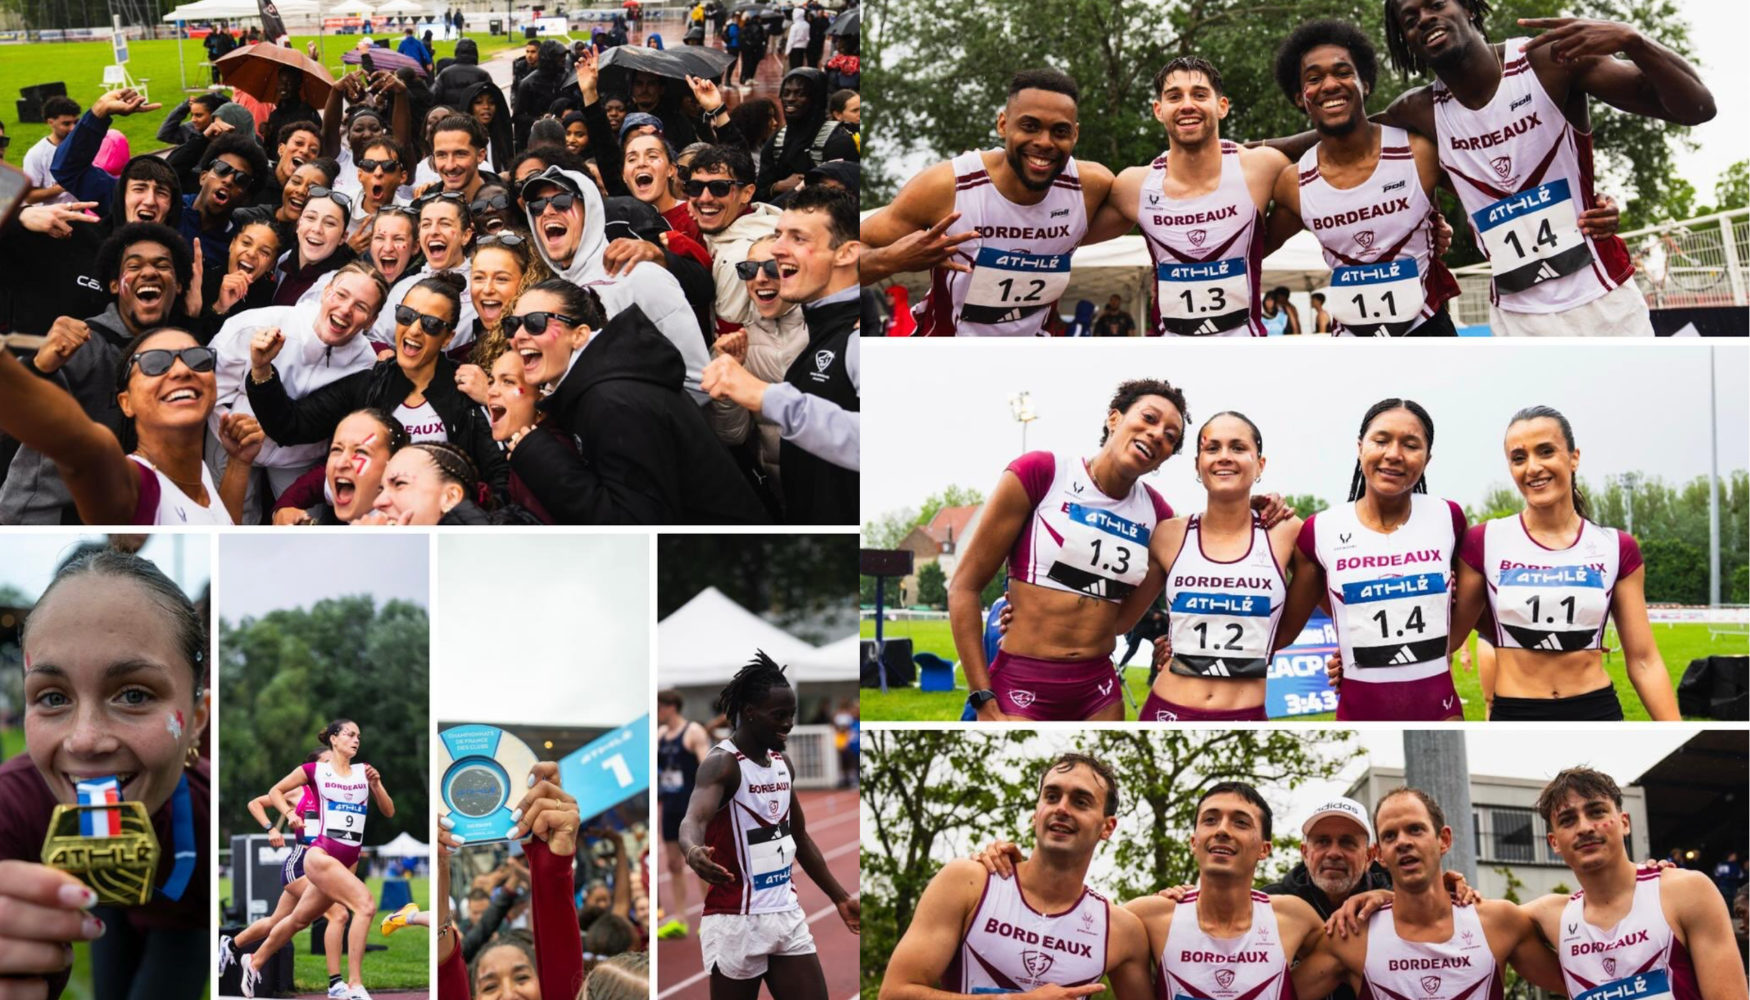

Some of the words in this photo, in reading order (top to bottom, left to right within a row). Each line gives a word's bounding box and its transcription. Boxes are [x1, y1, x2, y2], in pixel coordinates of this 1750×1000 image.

[1451, 112, 1542, 150] BORDEAUX
[1153, 205, 1238, 226] BORDEAUX
[1313, 197, 1410, 230] BORDEAUX
[1489, 186, 1551, 223] ATHLÉ
[974, 225, 1070, 239] BORDEAUX
[1504, 218, 1558, 259] 1.4
[996, 255, 1059, 269] ATHLÉ
[1171, 261, 1229, 278] ATHLÉ
[1341, 262, 1400, 282] ATHLÉ
[998, 278, 1046, 302] 1.2
[1179, 287, 1227, 313] 1.3
[1351, 290, 1397, 318] 1.1
[1085, 512, 1139, 538] ATHLÉ
[1090, 538, 1131, 575] 1.3
[1336, 549, 1442, 571] BORDEAUX
[1174, 576, 1273, 590] BORDEAUX
[1360, 574, 1428, 598] ATHLÉ
[1517, 566, 1587, 583] ATHLÉ
[1186, 597, 1254, 612] ATHLÉ
[1525, 595, 1575, 625] 1.1
[1372, 605, 1426, 638] 1.4
[1193, 622, 1244, 651] 1.2
[601, 752, 634, 788] 1
[345, 815, 354, 828] 9
[48, 836, 153, 865] ATHLÉ
[776, 844, 785, 864] 1
[984, 917, 1092, 959] BORDEAUX
[1571, 929, 1649, 956] BORDEAUX
[1181, 950, 1269, 964] BORDEAUX
[1388, 956, 1472, 971] BORDEAUX
